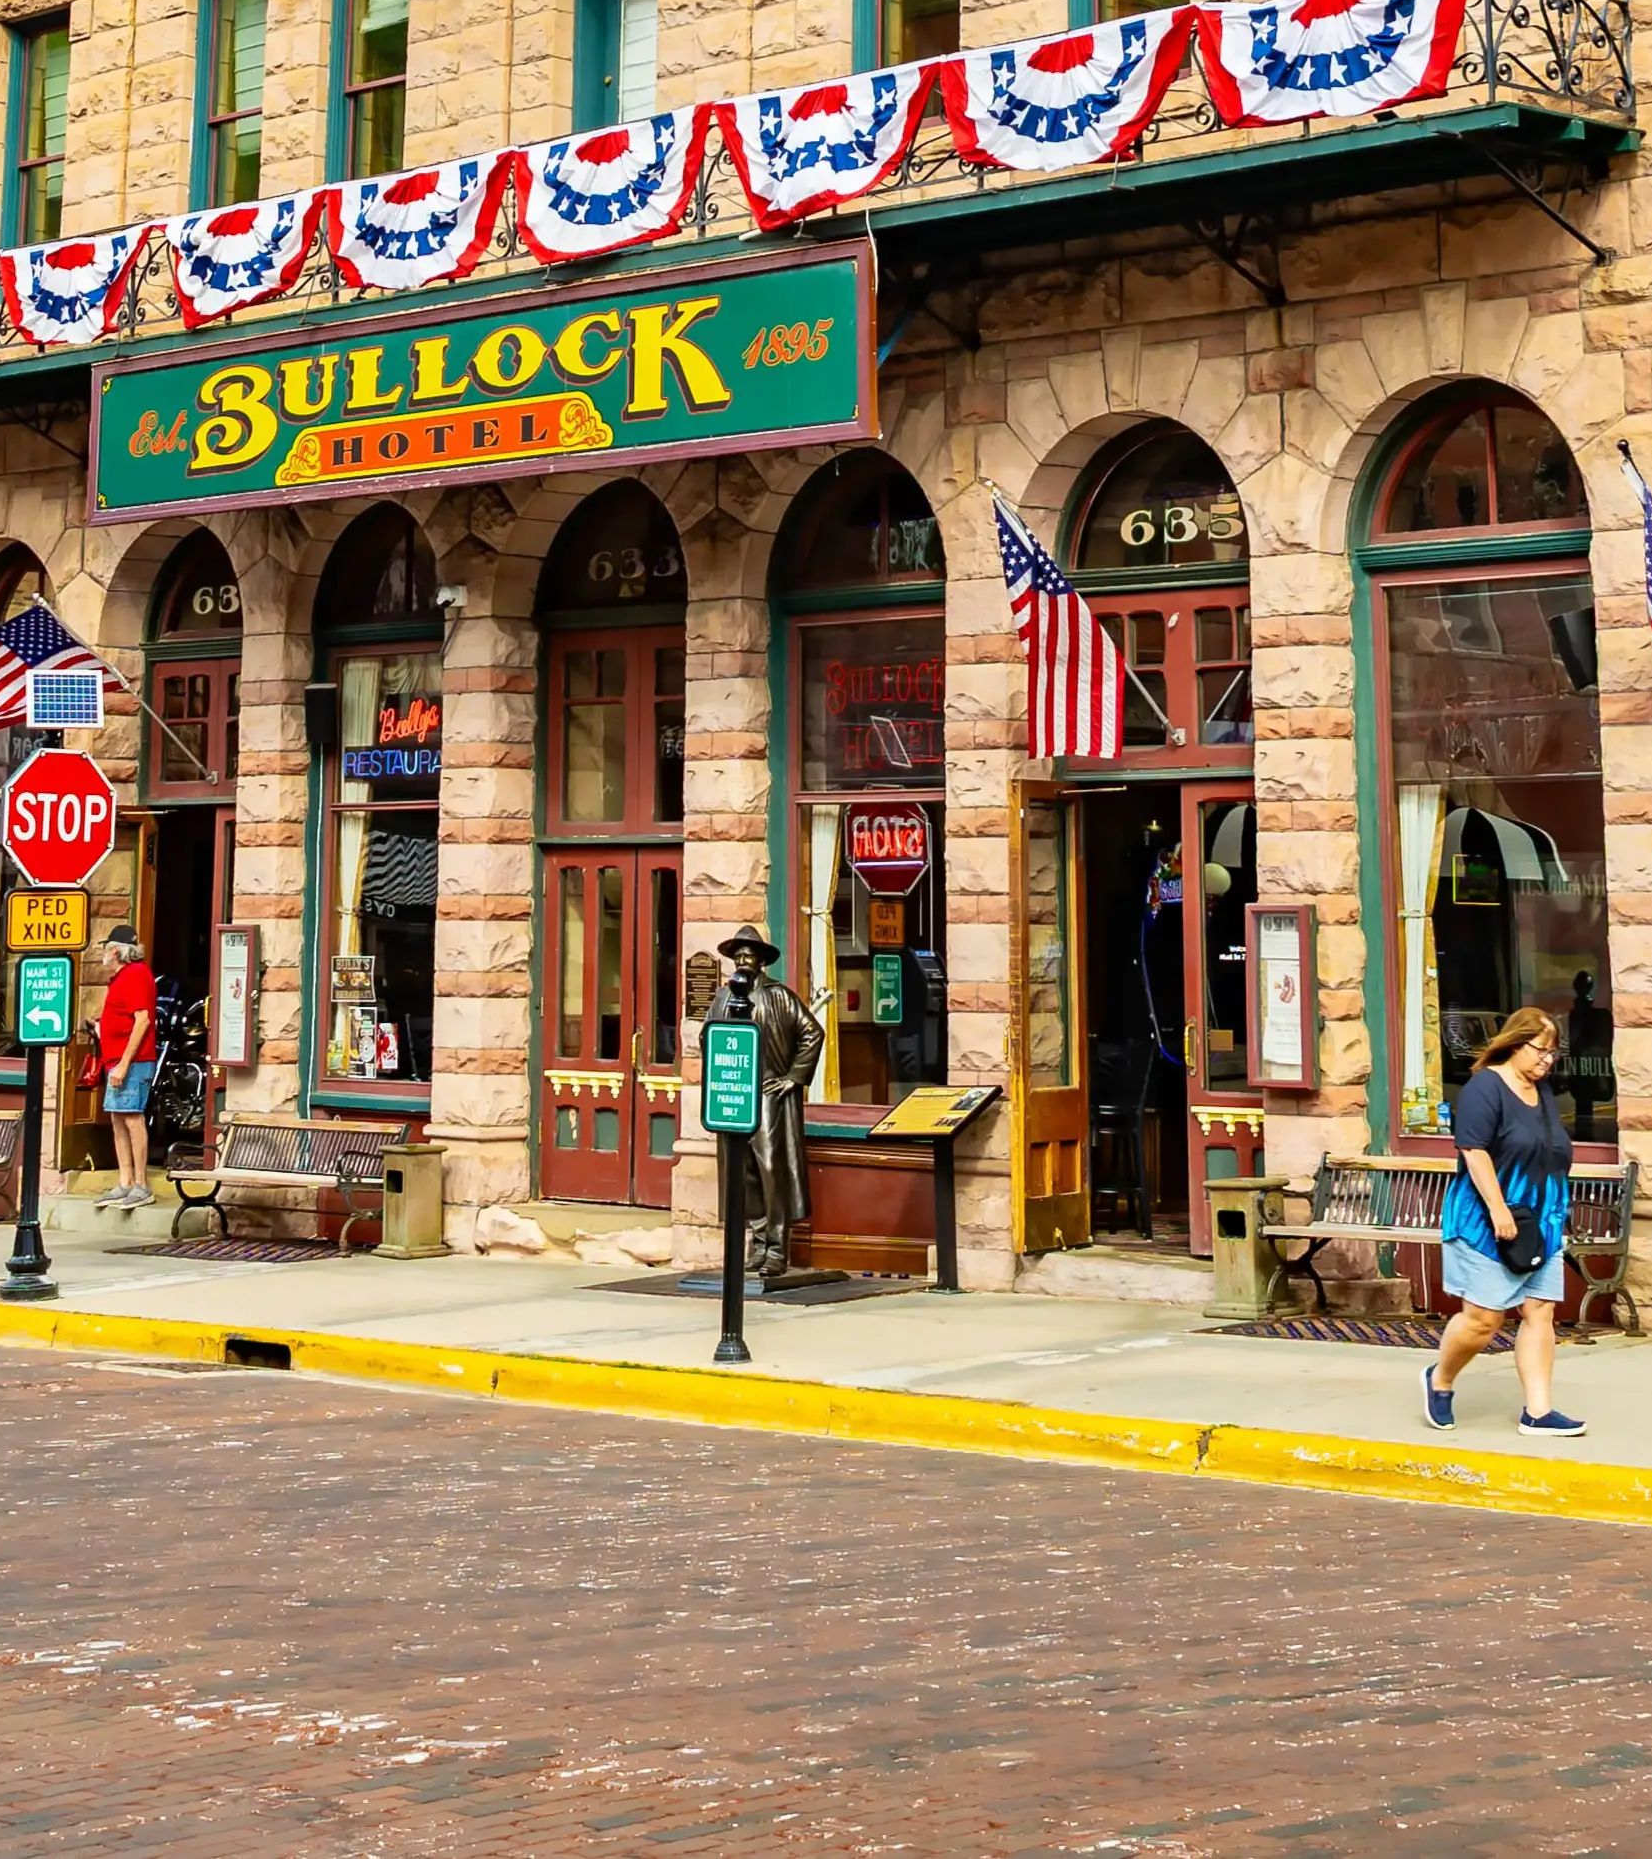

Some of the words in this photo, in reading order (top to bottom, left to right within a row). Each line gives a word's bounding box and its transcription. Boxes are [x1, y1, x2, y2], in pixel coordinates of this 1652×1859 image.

[128, 409, 187, 457] Est.
[184, 295, 733, 479] BULLOCK
[742, 317, 835, 369] 1895
[330, 411, 550, 468] HOTEL
[1120, 502, 1244, 546] 635
[12, 792, 107, 843] STOP
[27, 898, 68, 917] PED
[23, 922, 72, 941] XING
[26, 968, 47, 977] MAIN
[52, 967, 63, 977] ST
[26, 979, 63, 989] PARKING
[32, 991, 57, 1001] RAMP
[726, 1037, 738, 1050] 20
[714, 1053, 749, 1068] MINUTE
[721, 1070, 742, 1080] GUEST
[717, 1094, 745, 1105] PARKING
[722, 1107, 738, 1116] ONLY
